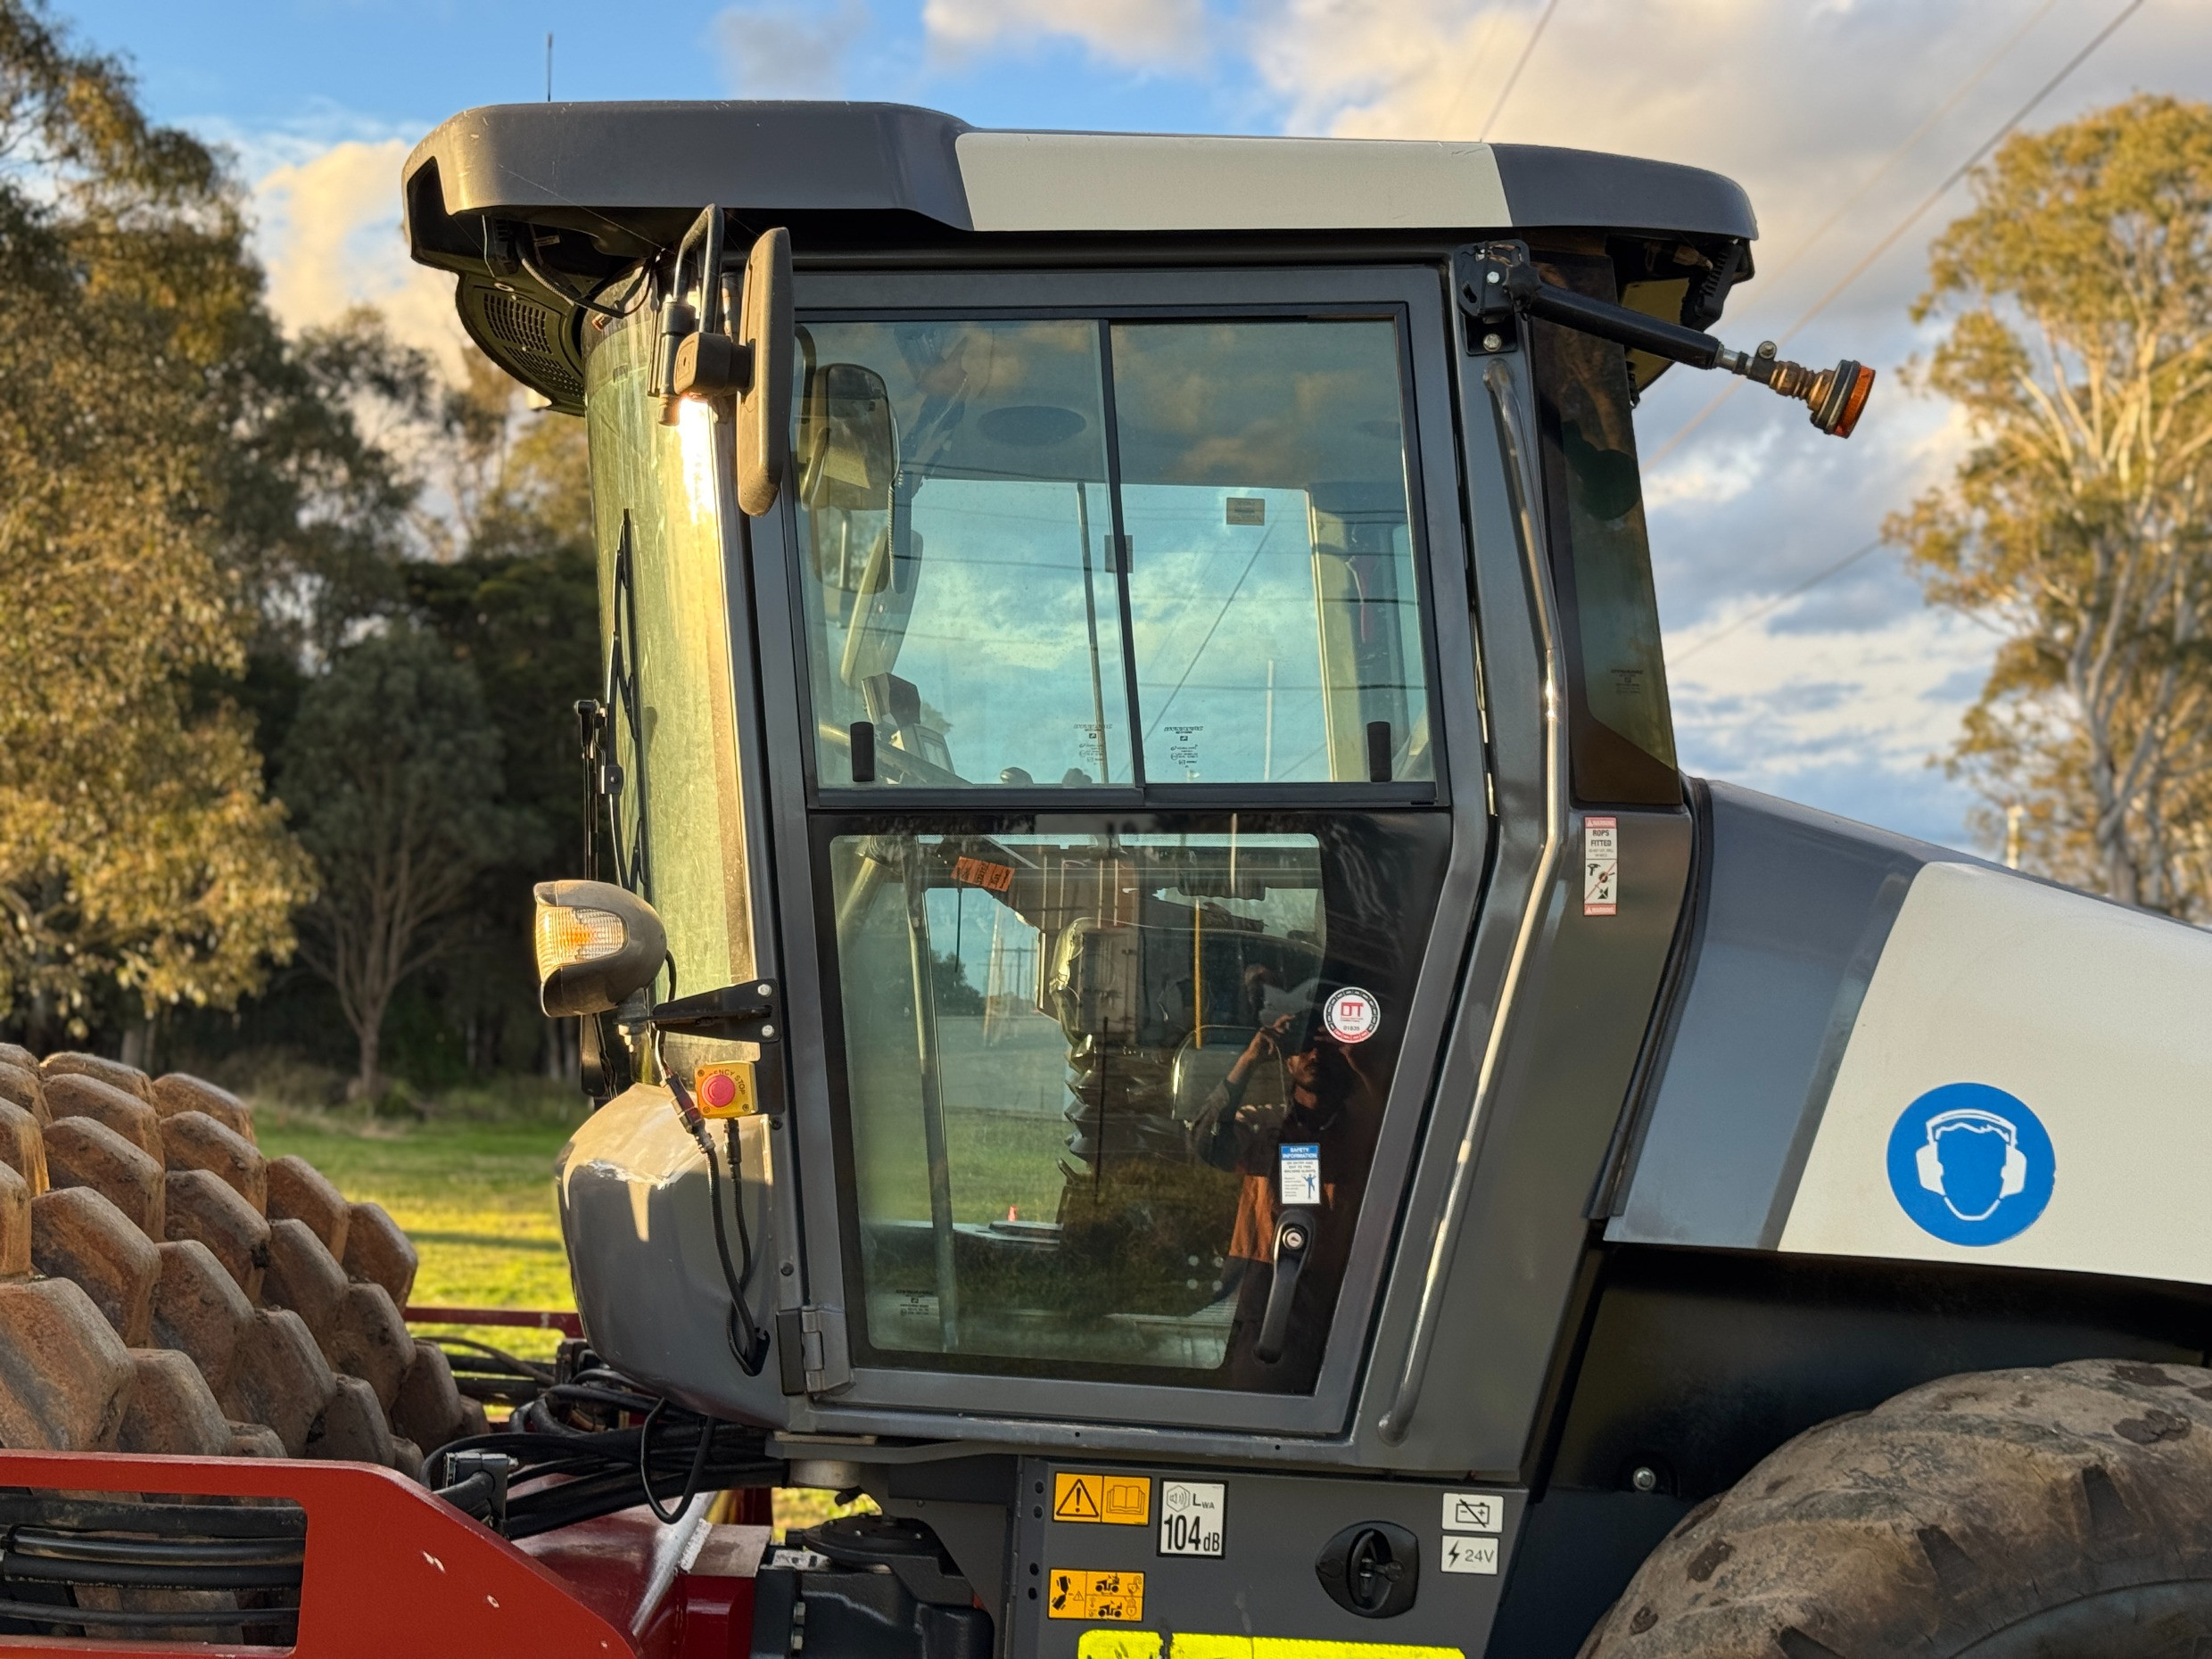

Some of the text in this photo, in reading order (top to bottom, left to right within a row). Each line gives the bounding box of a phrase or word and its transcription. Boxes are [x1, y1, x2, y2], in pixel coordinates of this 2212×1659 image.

[734, 1075, 746, 1095] STOP
[1163, 1514, 1220, 1552] 104 dB
[1465, 1548, 1495, 1564] 24V
